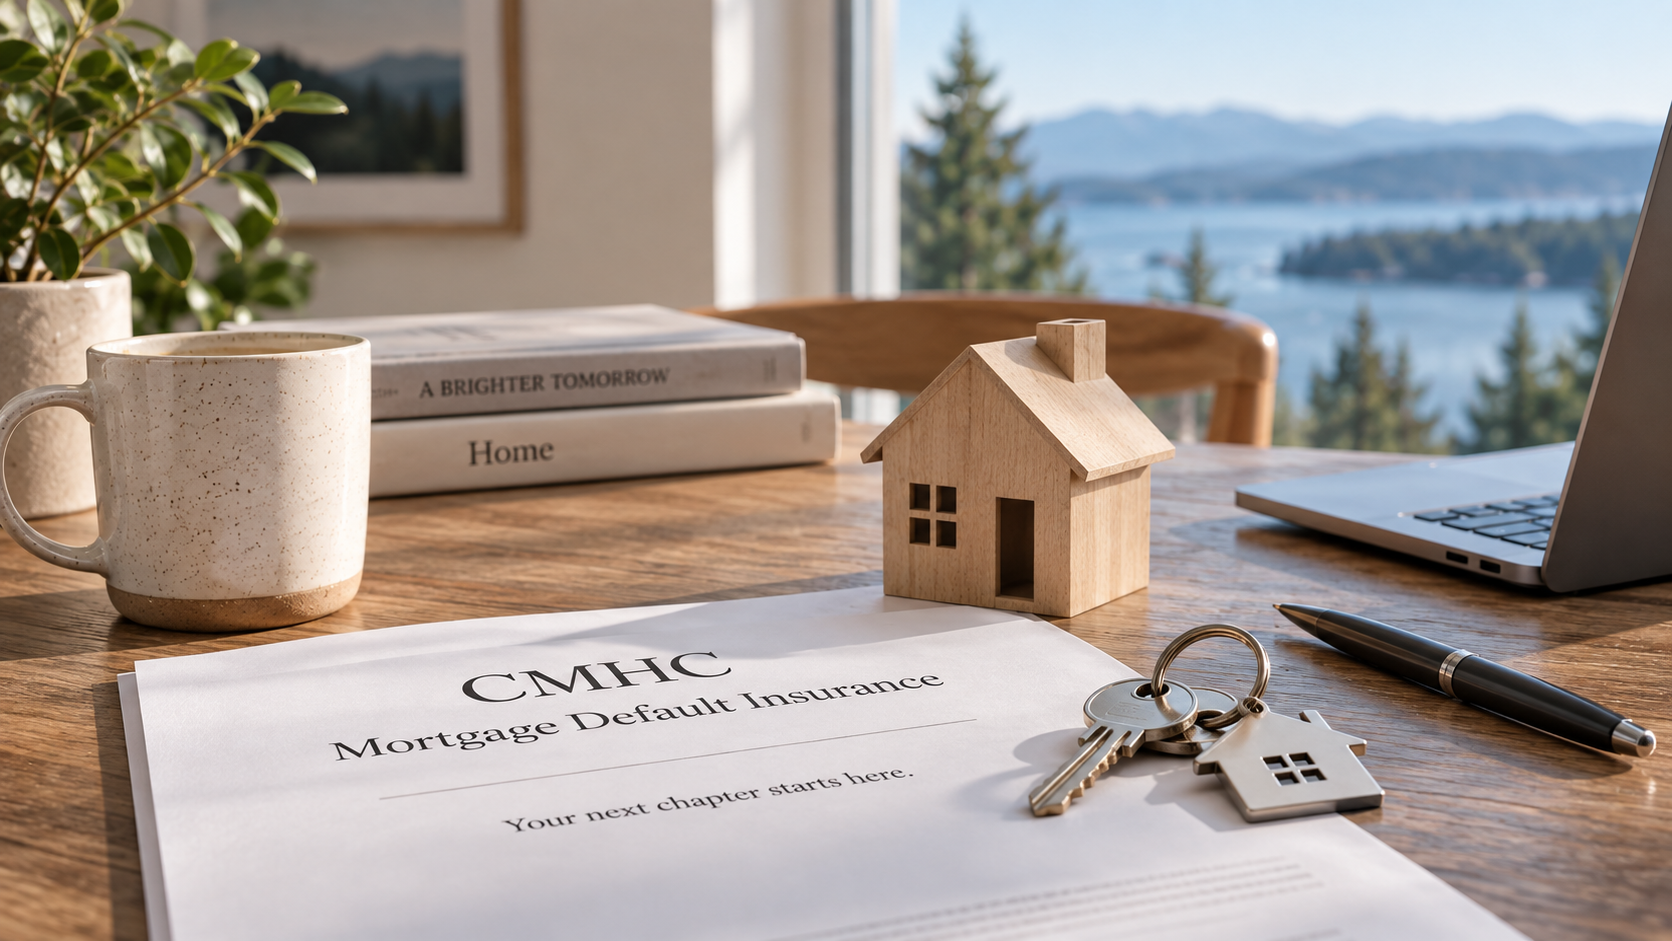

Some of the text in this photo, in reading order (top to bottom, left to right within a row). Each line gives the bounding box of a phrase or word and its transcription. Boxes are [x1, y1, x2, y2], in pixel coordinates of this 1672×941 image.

[419, 380, 436, 399] A
[440, 374, 545, 397] BRIGHTER
[552, 368, 671, 391] TOMORROW
[468, 439, 555, 467] Home
[461, 651, 733, 703] CMHC
[329, 671, 945, 762] Mortgage Default Insurance
[502, 767, 915, 834] Your next chapter starts here.
